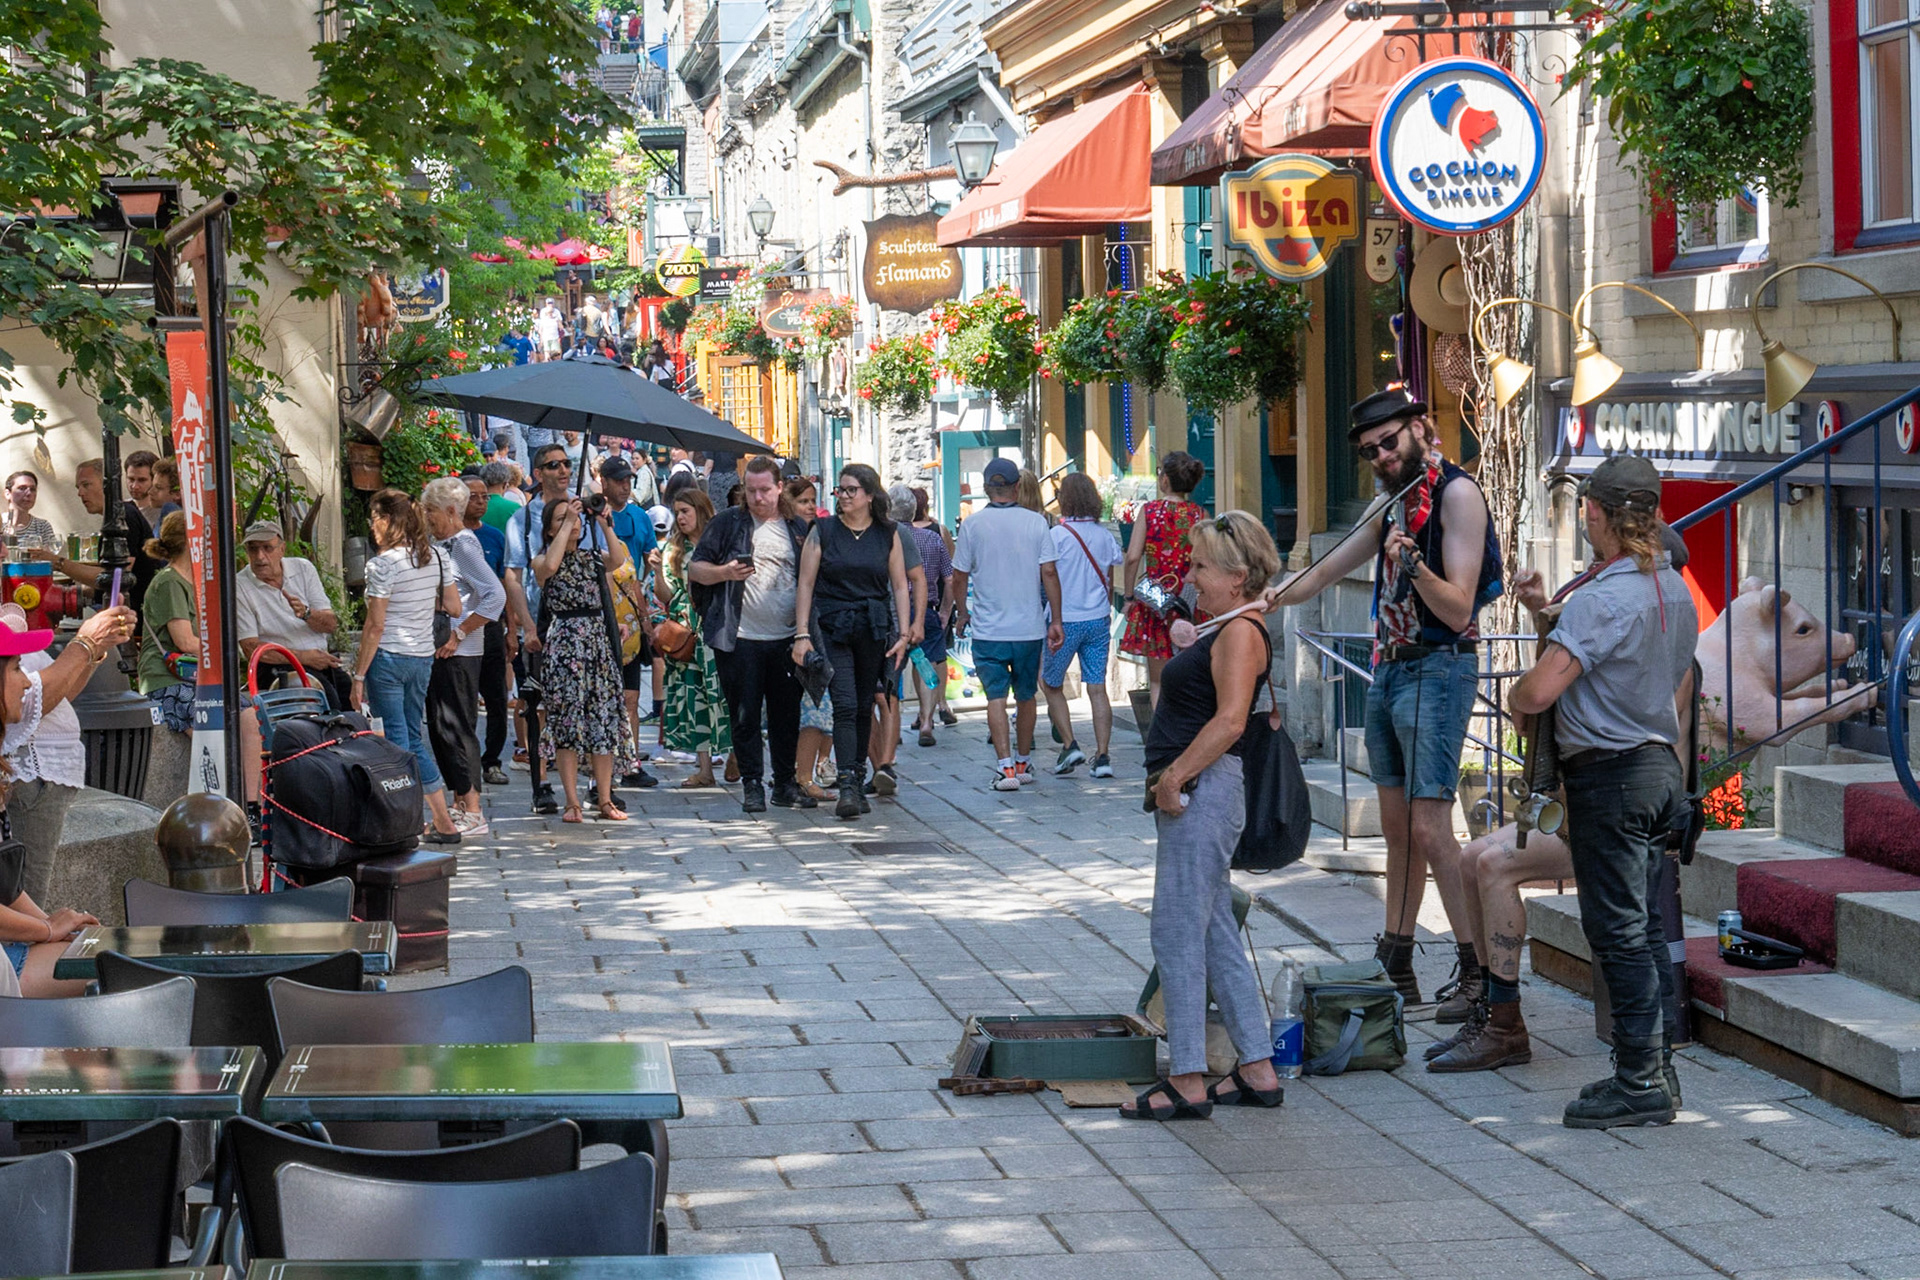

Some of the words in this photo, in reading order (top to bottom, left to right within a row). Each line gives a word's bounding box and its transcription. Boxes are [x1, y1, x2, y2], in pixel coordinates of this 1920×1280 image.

[1408, 160, 1516, 183] COCHON
[1427, 186, 1500, 200] DINGUE
[1236, 187, 1350, 230] Ibiza
[1372, 227, 1394, 246] 57
[664, 263, 699, 276] ZAZOU
[875, 259, 952, 286] Flamand
[1595, 401, 1694, 452] COCHON
[1697, 401, 1801, 454] DINGUE
[203, 514, 215, 581] RESTOS
[380, 774, 412, 792] Roland
